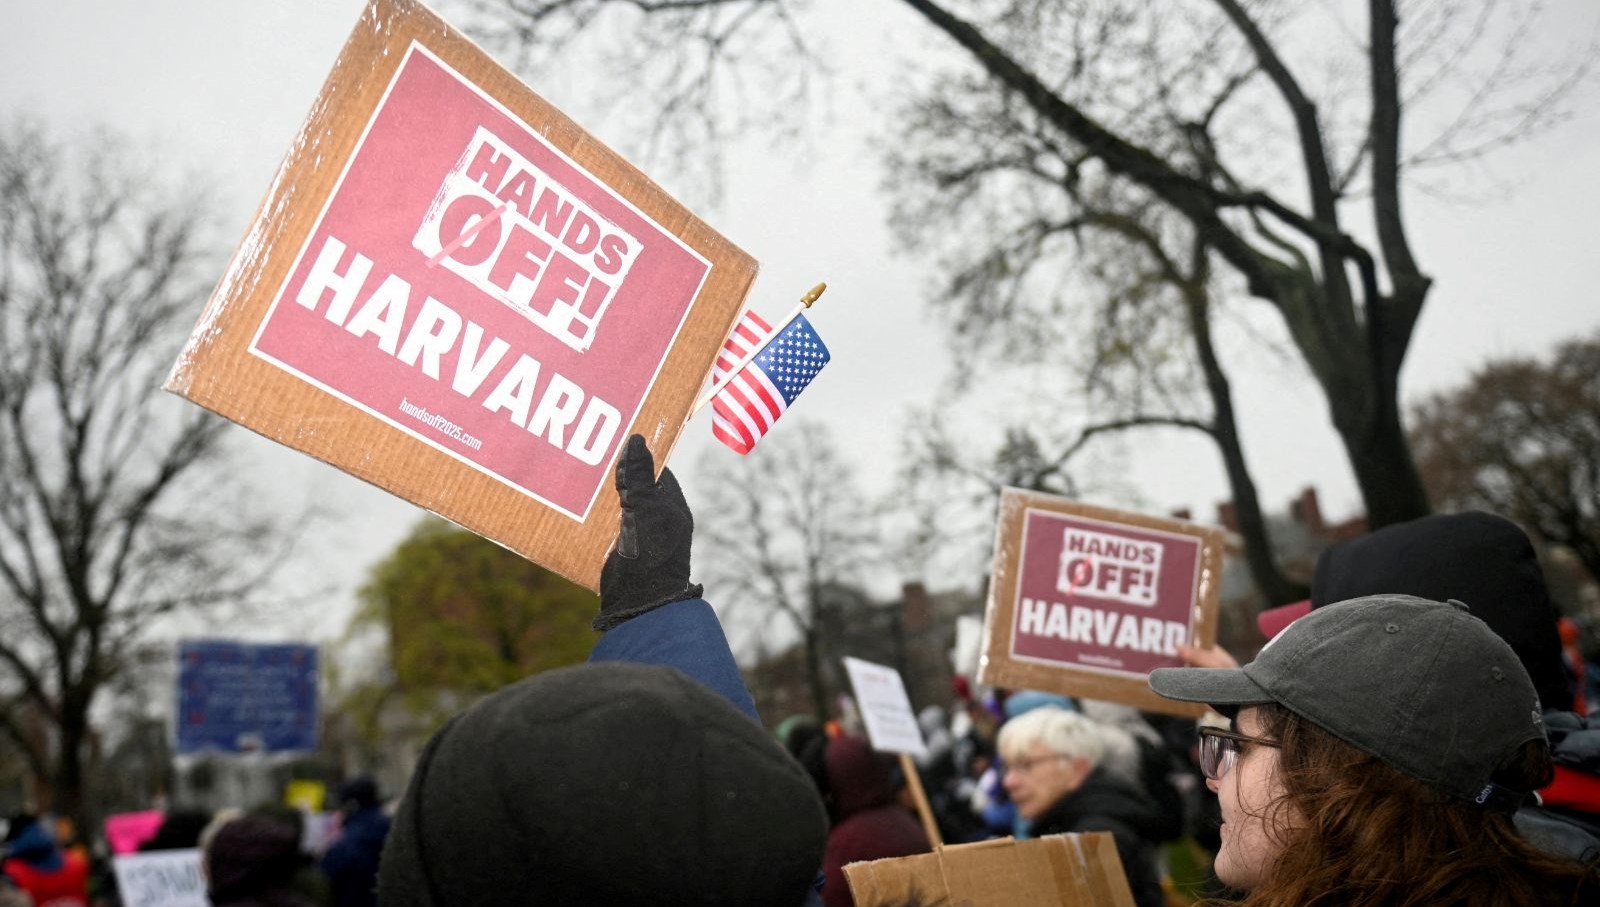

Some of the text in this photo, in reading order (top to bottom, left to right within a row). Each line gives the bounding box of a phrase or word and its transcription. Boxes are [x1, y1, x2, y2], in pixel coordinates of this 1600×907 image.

[466, 141, 628, 275] HANDS
[439, 195, 611, 339] OFF!
[294, 235, 622, 466] HARVARD
[399, 396, 482, 451] handsoff2025.com
[1069, 534, 1155, 563] HANDS
[1066, 558, 1154, 598] OFF!
[1020, 598, 1187, 656] HARVARD
